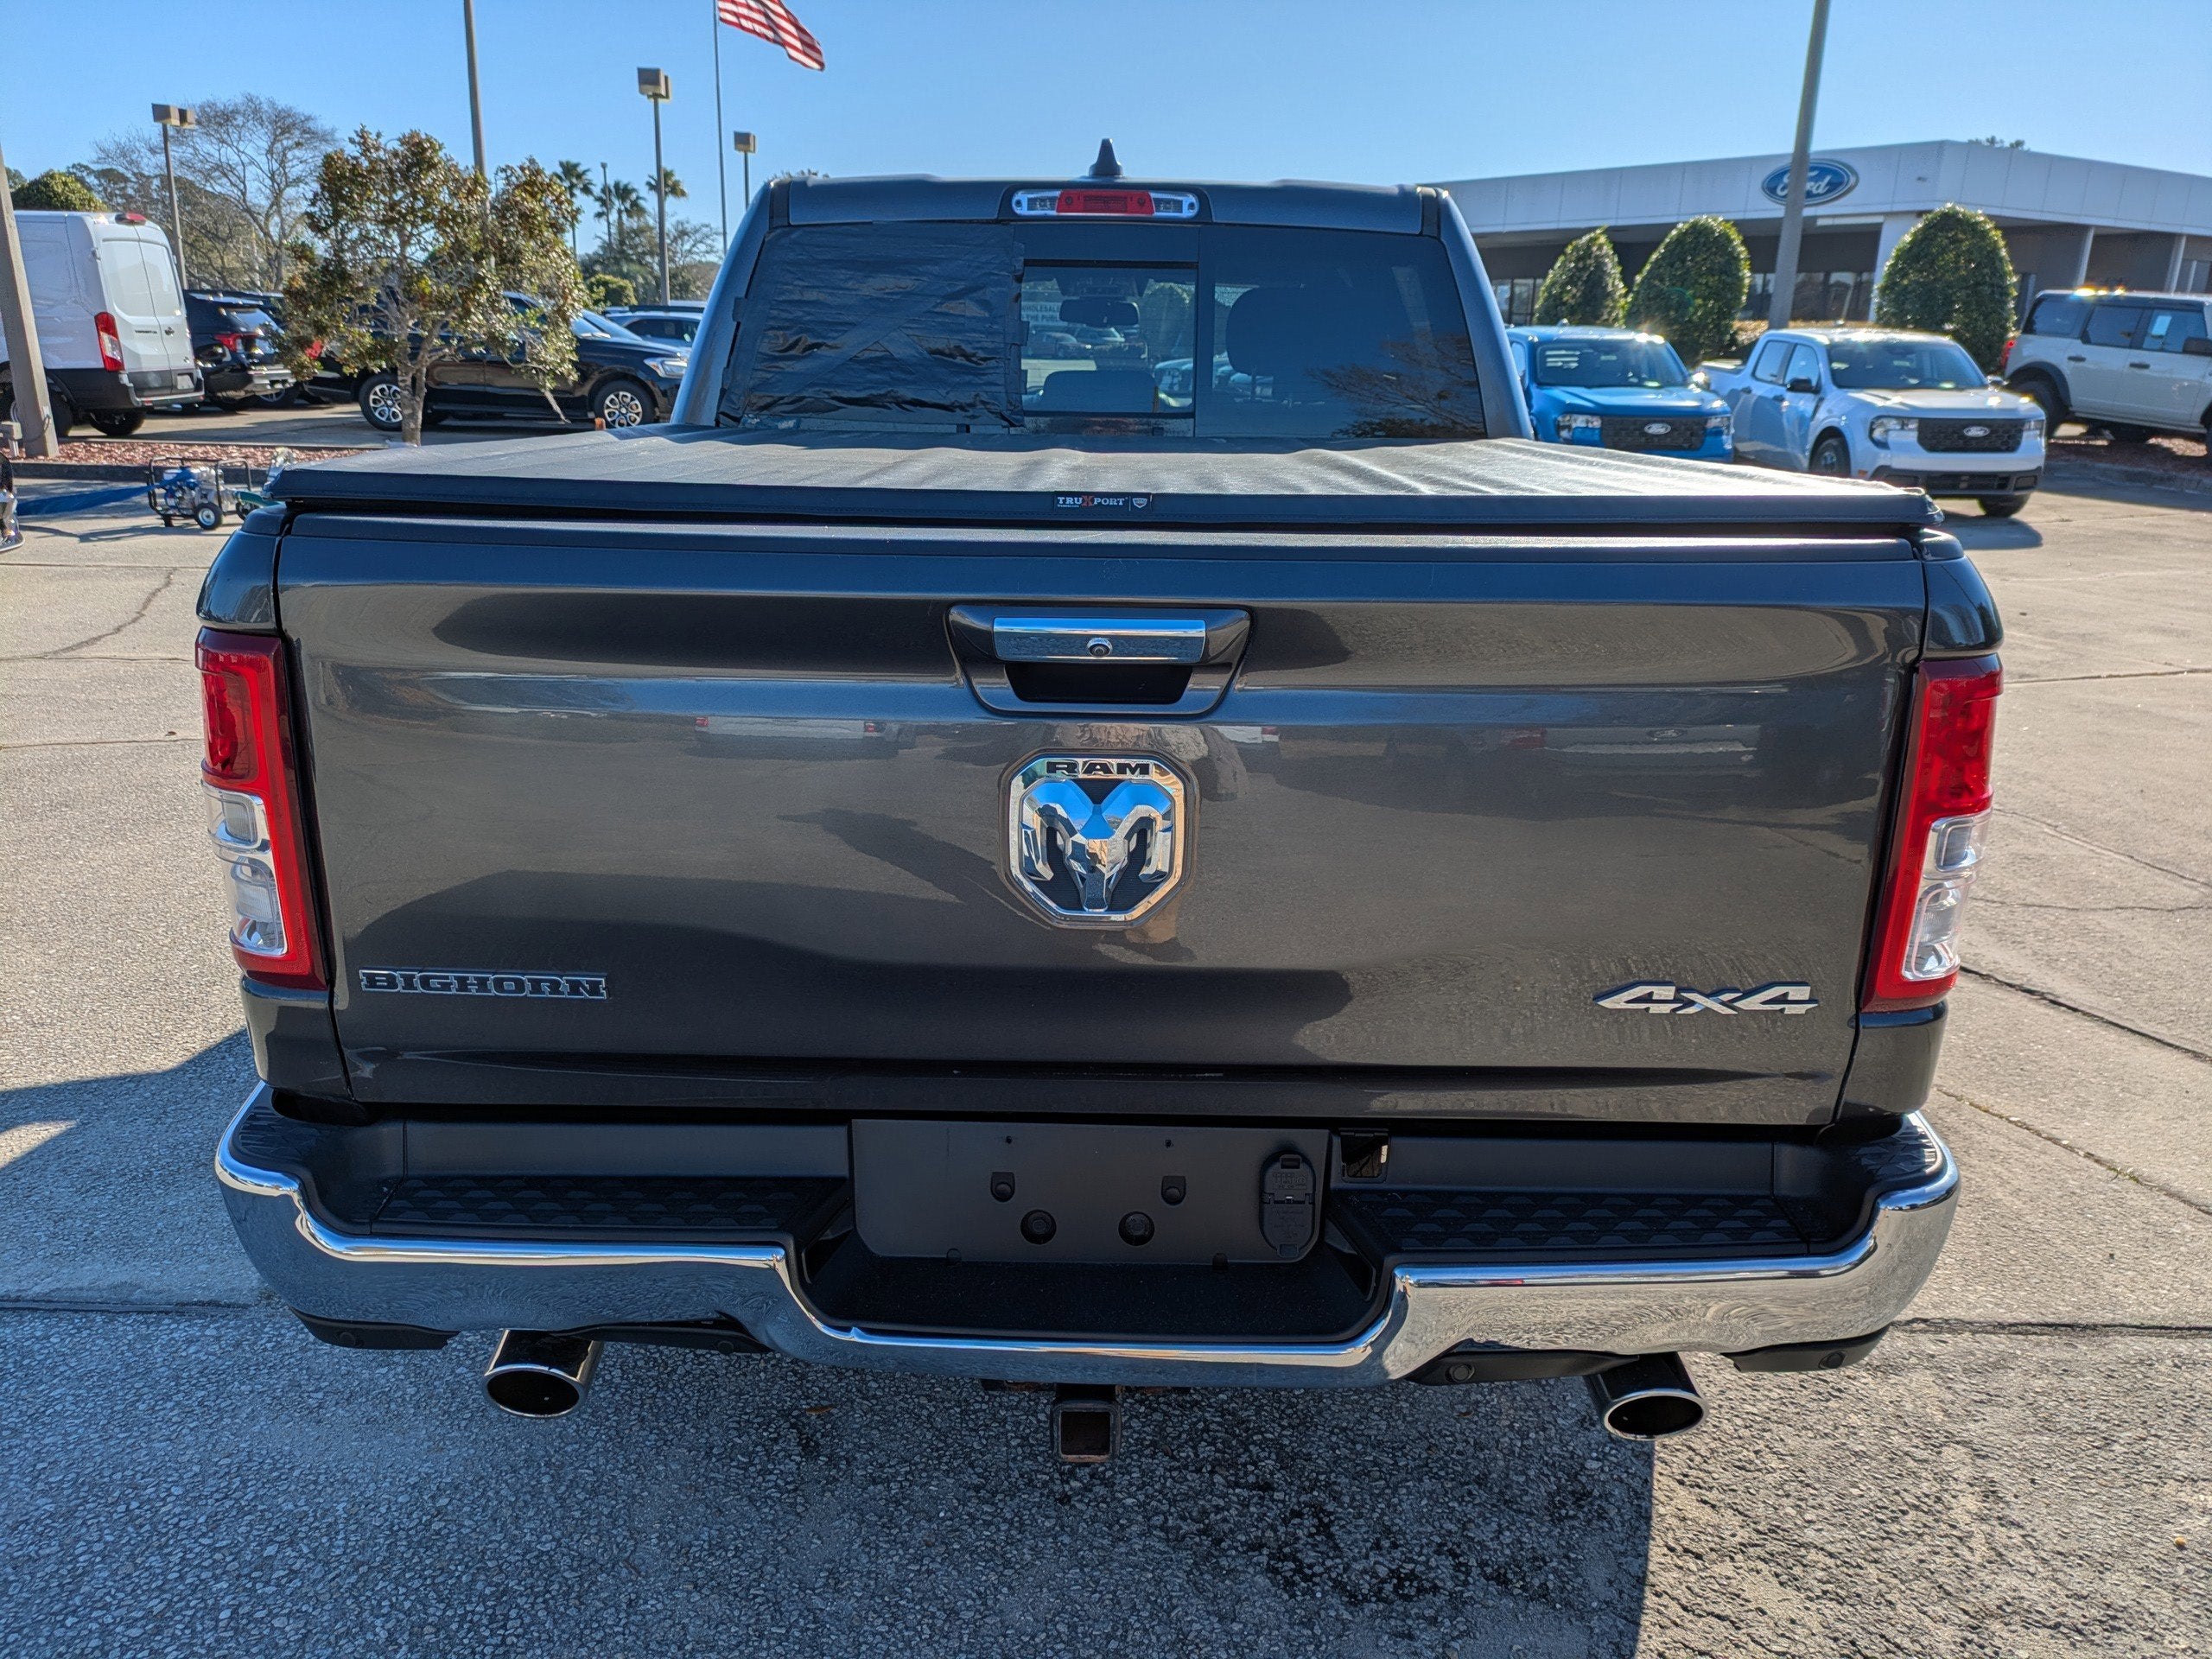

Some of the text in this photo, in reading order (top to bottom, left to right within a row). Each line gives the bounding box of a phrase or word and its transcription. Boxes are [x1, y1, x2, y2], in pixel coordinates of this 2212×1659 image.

[1777, 170, 1832, 196] Frd
[1057, 495, 1125, 506] TRUXPORT
[1046, 760, 1151, 776] RAM
[359, 969, 607, 999] BIGHORN
[1594, 983, 1818, 1014] 4x4
